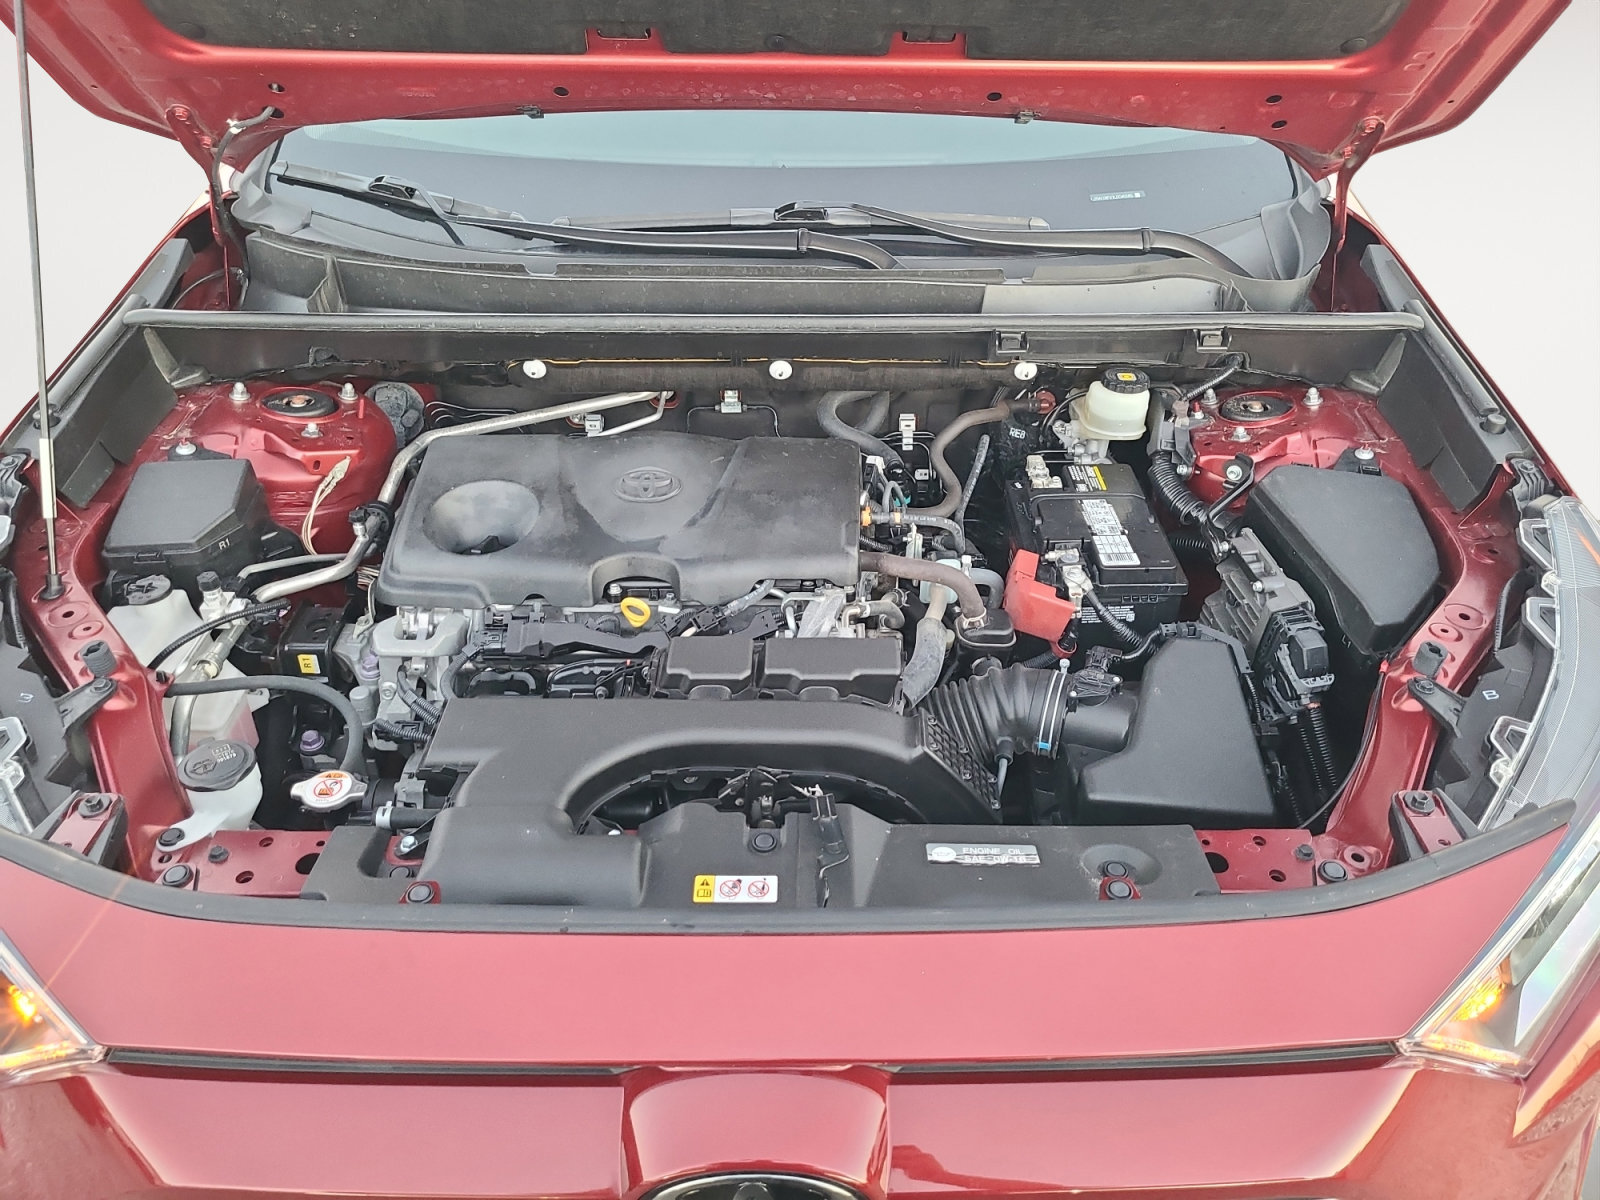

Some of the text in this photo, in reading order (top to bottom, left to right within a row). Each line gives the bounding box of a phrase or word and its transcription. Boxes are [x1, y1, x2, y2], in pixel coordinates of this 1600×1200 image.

[218, 537, 230, 551] R1
[302, 657, 312, 669] R1
[962, 847, 1001, 855] ENGINE
